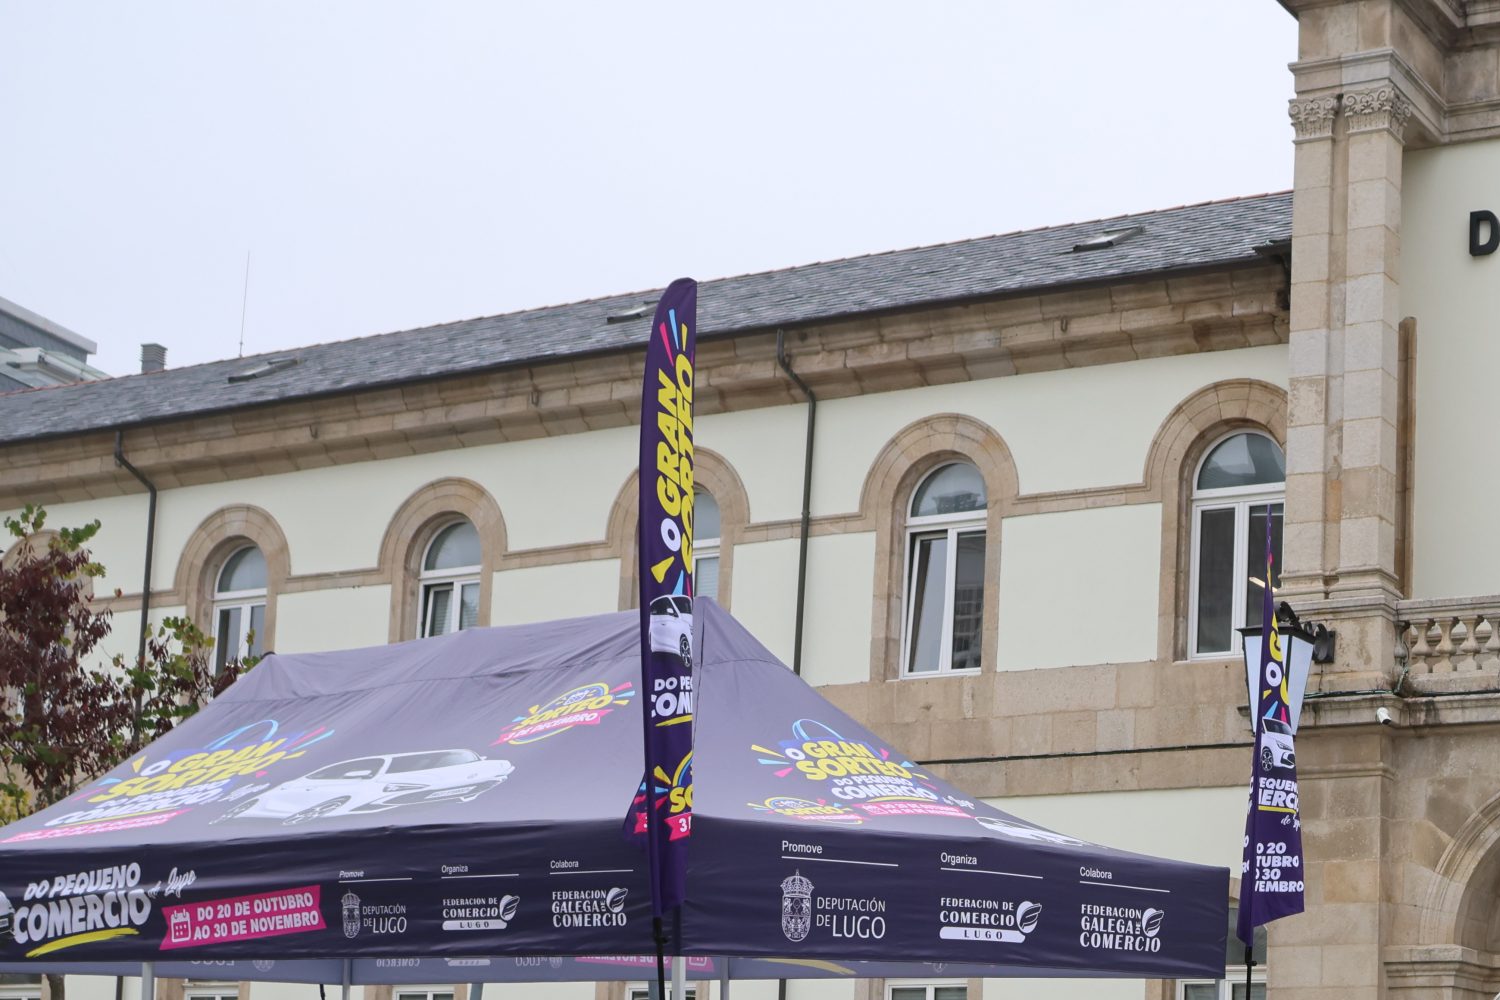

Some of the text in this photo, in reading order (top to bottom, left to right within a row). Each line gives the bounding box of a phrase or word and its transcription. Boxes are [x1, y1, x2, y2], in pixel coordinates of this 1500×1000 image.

[657, 368, 681, 552] O GRAN
[654, 675, 693, 691] DO PE
[785, 740, 875, 761] O GRAN
[796, 756, 913, 780] SORTEO
[833, 774, 913, 787] DO PEQUENO
[831, 784, 938, 800] COMERCIO
[781, 841, 823, 855] Promove
[1266, 842, 1287, 854] 20
[550, 859, 579, 869] Colabora
[941, 852, 978, 867] Organiza
[339, 869, 364, 879] Promove
[441, 864, 468, 875] Organiza
[1080, 866, 1113, 880] Colabora
[1262, 868, 1281, 880] 30
[24, 862, 142, 901] DO PEQUENO
[443, 896, 498, 906] FEDERACION DE
[552, 889, 607, 900] FEDERACION
[197, 892, 314, 921] DO 20 DE OUTUBRO
[362, 903, 407, 915] DEPUTACIÓN
[552, 900, 598, 913] GALEGA
[817, 896, 886, 913] DEPUTACIÓN
[941, 897, 1015, 911] FEDERACION DE
[1081, 904, 1142, 919] FEDERACION
[13, 889, 152, 945] COMERCIO
[443, 907, 499, 919] COMERCIO
[552, 912, 628, 928] COMERCIO
[940, 911, 1015, 926] COMERCIO
[193, 909, 320, 941] AO 30 DE NOVEMBRO
[364, 916, 407, 933] DE LUGO
[459, 920, 490, 929] LUGO
[817, 914, 886, 940] DE LUGO
[1081, 915, 1134, 935] GALEGA
[963, 928, 1004, 940] LUGO
[1079, 933, 1161, 953] COMERCIO
